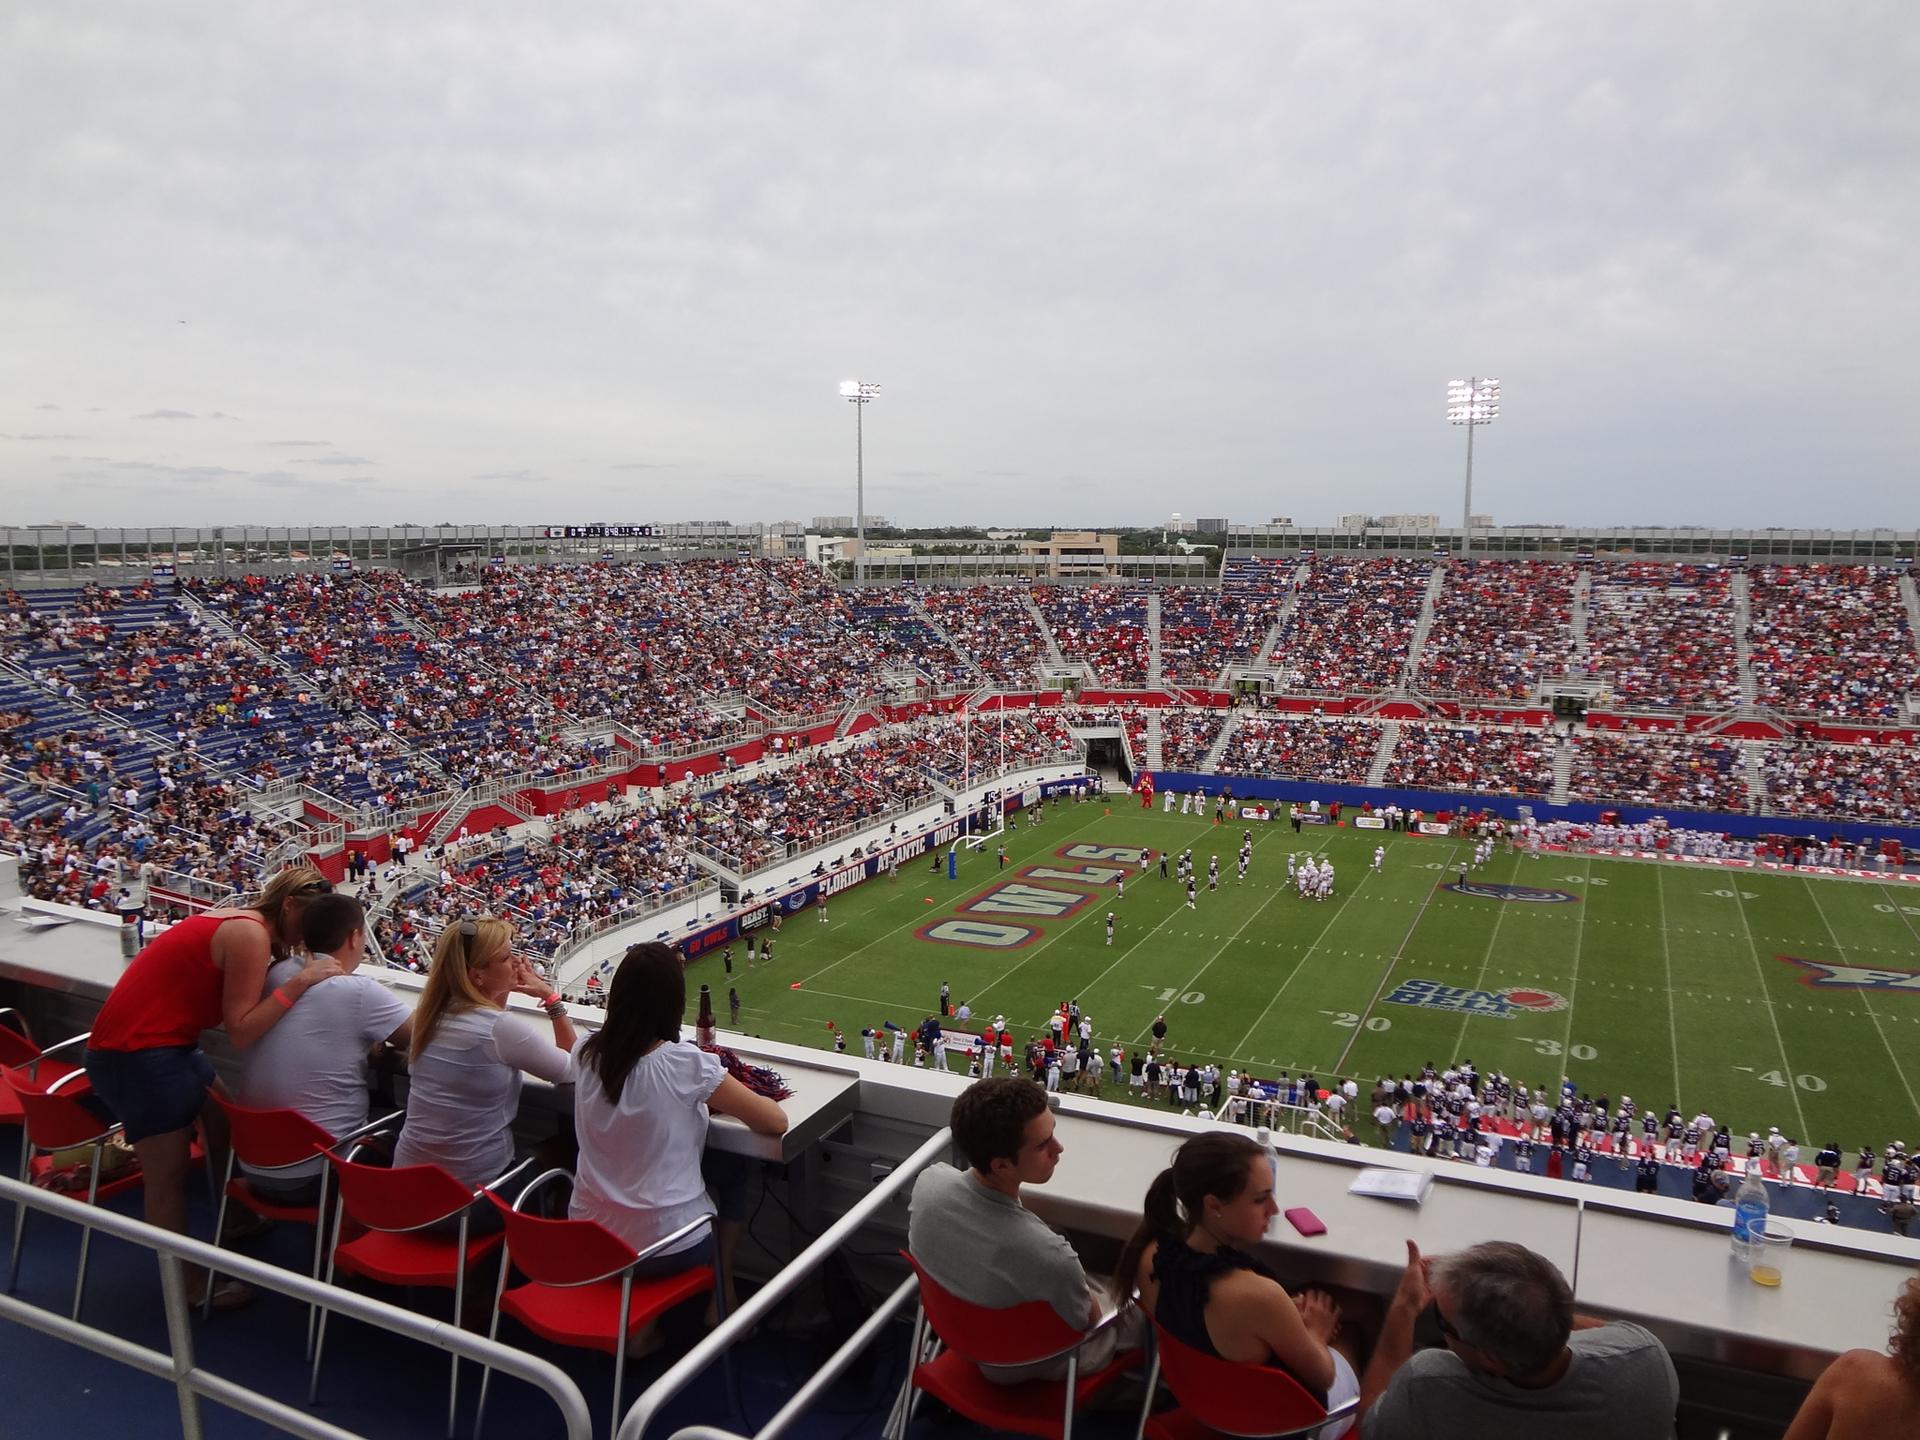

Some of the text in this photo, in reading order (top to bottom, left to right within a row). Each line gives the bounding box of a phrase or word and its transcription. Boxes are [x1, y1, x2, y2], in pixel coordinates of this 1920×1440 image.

[818, 862, 867, 896] FLORIDA
[934, 822, 959, 847] OWLS
[924, 843, 1149, 948] OWLS
[704, 927, 728, 948] OWLS
[1156, 987, 1206, 1005] 10
[1332, 1012, 1392, 1032] 20
[1535, 1039, 1598, 1060] 30
[1757, 1070, 1828, 1092] 40
